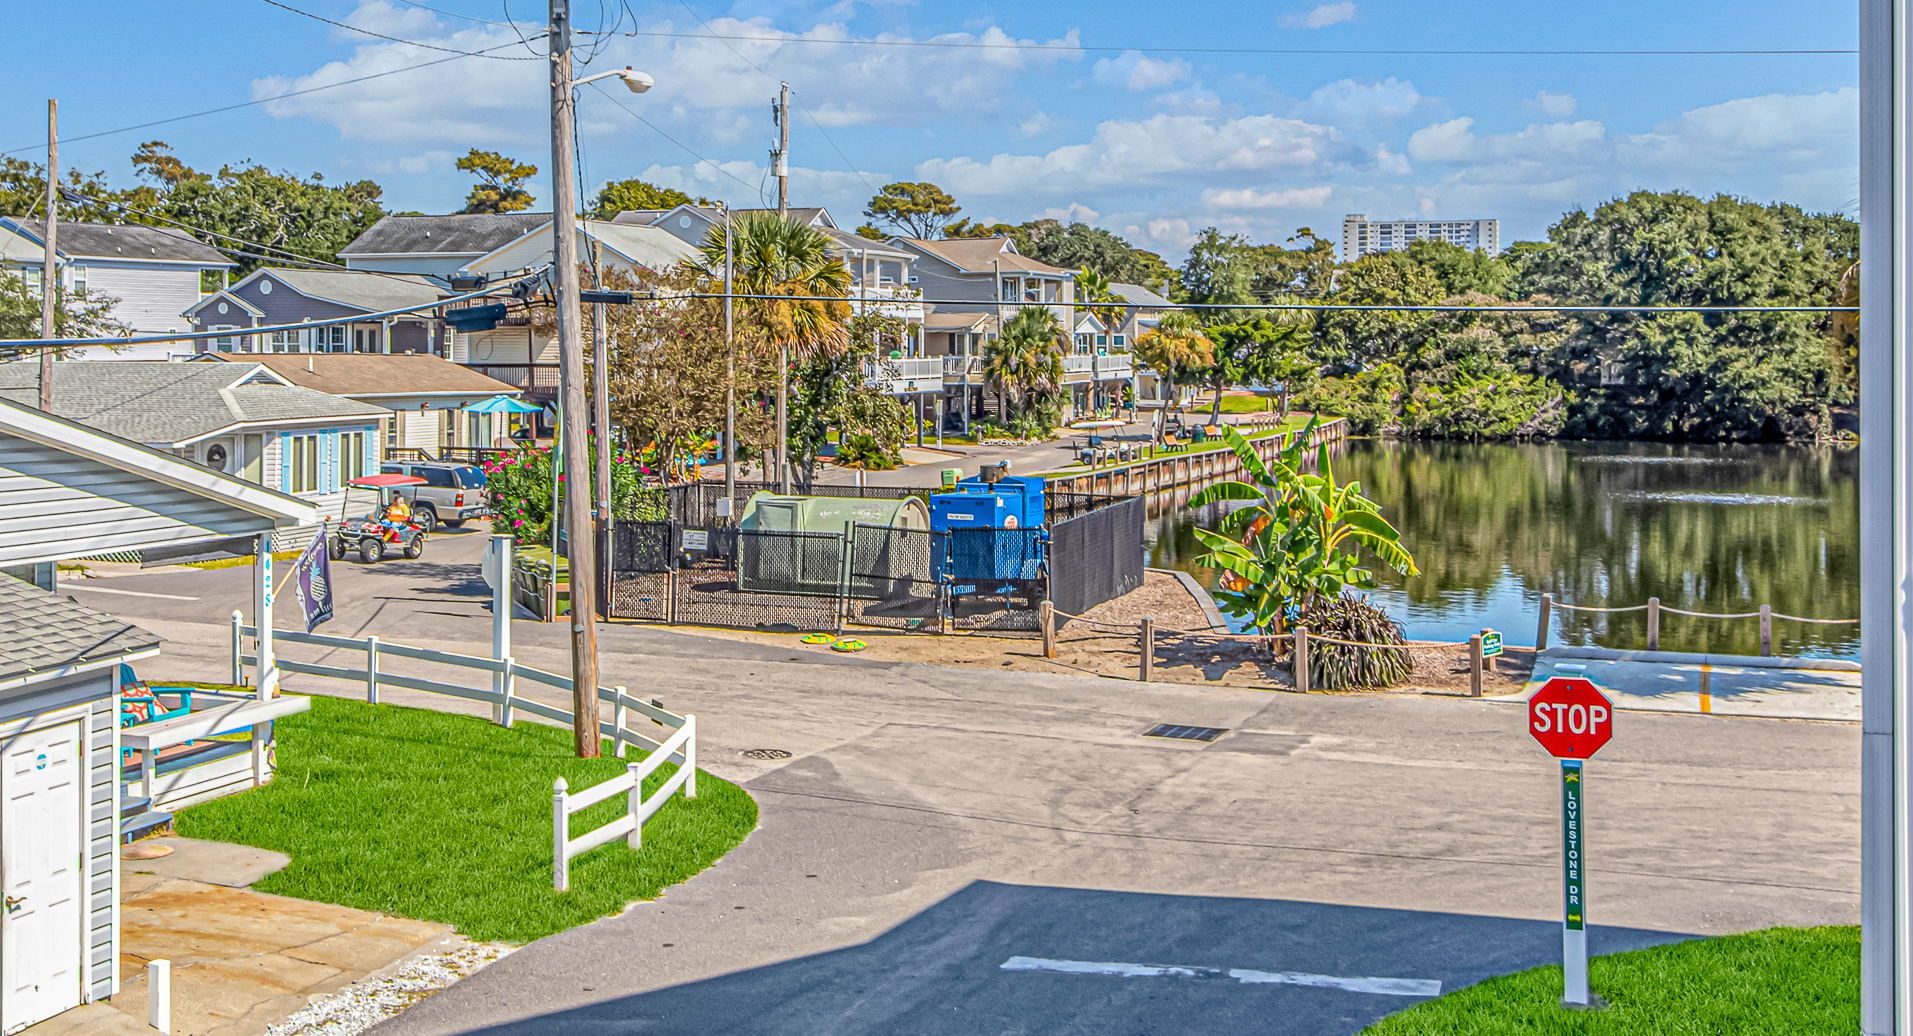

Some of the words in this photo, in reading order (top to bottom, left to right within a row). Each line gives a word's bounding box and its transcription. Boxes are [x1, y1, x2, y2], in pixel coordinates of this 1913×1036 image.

[1533, 702, 1608, 735] STOP
[1567, 790, 1578, 880] LOVESTONE
[1569, 885, 1579, 905] DR
